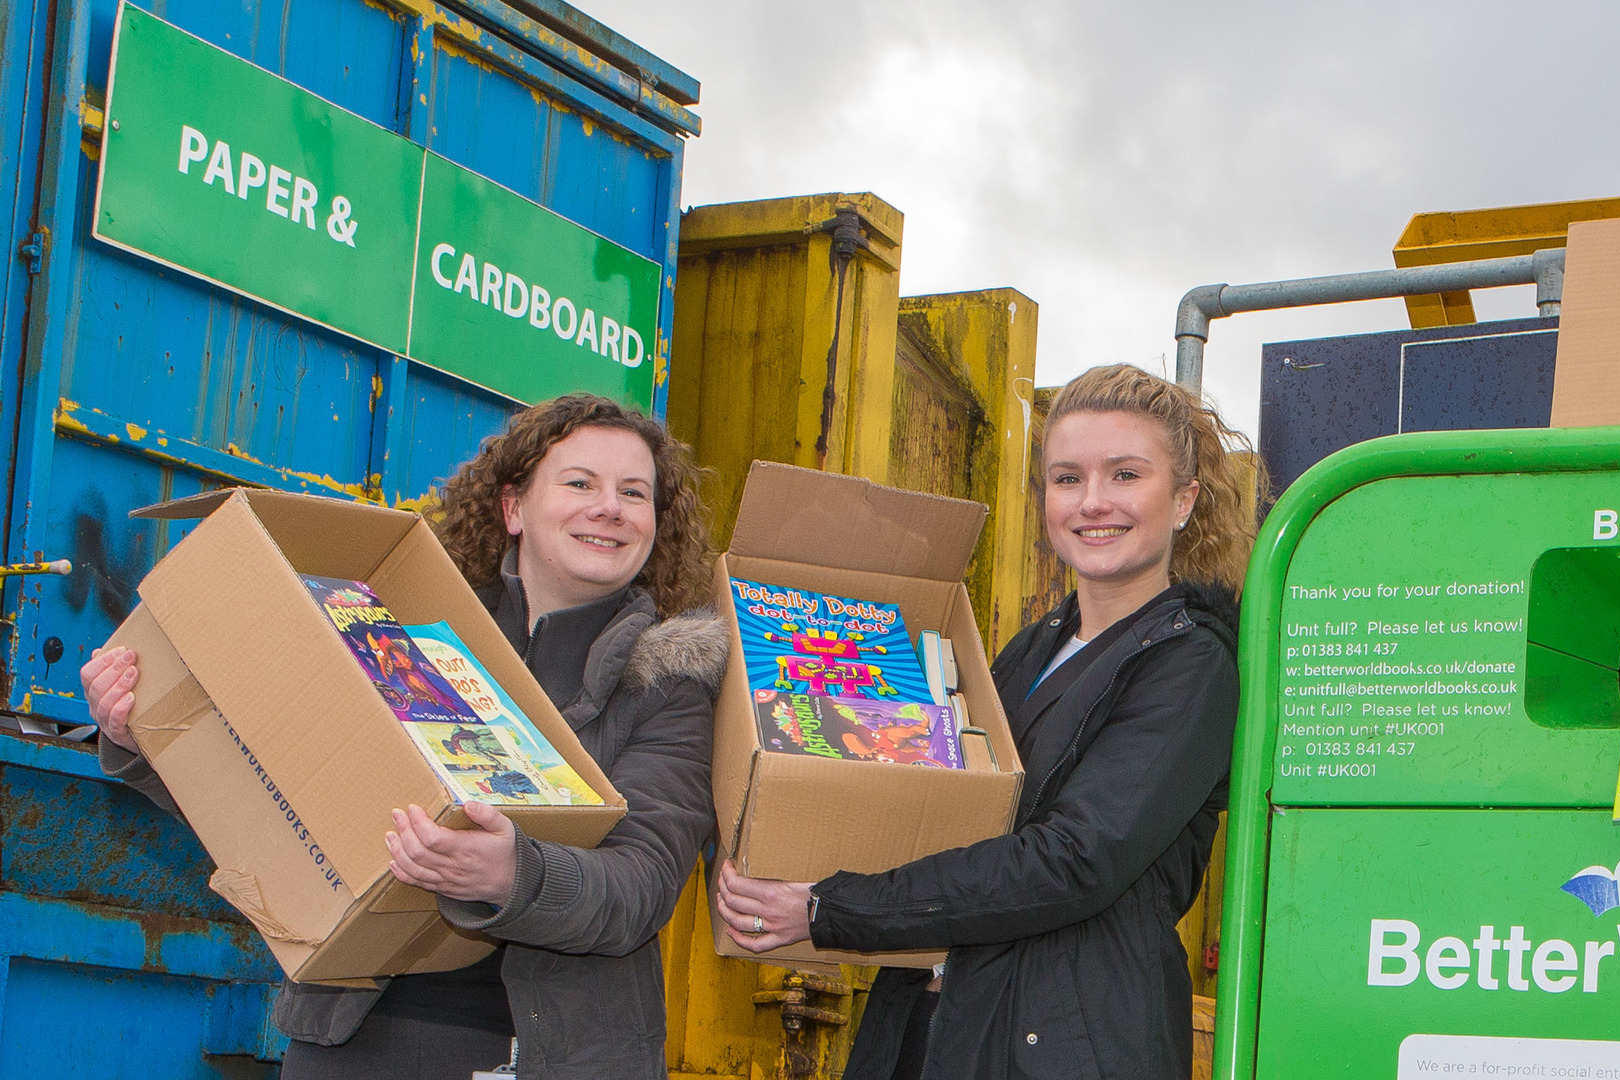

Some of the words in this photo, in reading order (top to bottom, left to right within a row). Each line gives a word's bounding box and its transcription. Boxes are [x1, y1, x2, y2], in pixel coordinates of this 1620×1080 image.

[177, 124, 319, 230] PAPER
[326, 195, 359, 249] &
[430, 242, 645, 369] CARDBOARD
[1290, 585, 1337, 600] Thank
[1342, 587, 1371, 601] you
[1377, 583, 1400, 598] for
[1404, 585, 1441, 600] your
[1446, 580, 1524, 596] donation!
[731, 580, 819, 615] Totally
[822, 595, 897, 625] Dotty
[323, 603, 396, 632] Astrosaurs
[1287, 623, 1319, 637] Unit
[1325, 621, 1358, 636] full?
[1367, 621, 1419, 635] Please
[1424, 619, 1445, 634] let
[1450, 621, 1468, 634] us
[1474, 618, 1523, 632] know!
[1287, 646, 1299, 660] p:
[1302, 643, 1342, 657] 01383
[1345, 643, 1369, 656] 841
[1373, 642, 1398, 656] 437
[1285, 667, 1301, 677] w:
[1304, 660, 1516, 677] betterworldbooks.co.uk/donate
[1284, 685, 1296, 697] e:
[1299, 680, 1518, 697] unitfull@betterworldbooks.co.uk
[1284, 703, 1315, 717] Unit
[1321, 703, 1353, 716] full?
[1362, 703, 1412, 716] Please
[1417, 702, 1436, 716] let
[1441, 704, 1459, 716] us
[1464, 702, 1511, 716] know!
[789, 693, 843, 760] Astrosaurs
[941, 708, 951, 737] Ghosts
[1283, 722, 1345, 736] Mention
[1350, 722, 1379, 736] unit
[1385, 722, 1444, 736] #UK001
[946, 738, 958, 762] Space
[1282, 744, 1296, 758] p:
[1305, 742, 1351, 756] 01383
[1355, 742, 1381, 756] 841
[1386, 742, 1416, 756] 437
[1281, 763, 1312, 777] Unit
[1317, 763, 1376, 777] #UK001
[1416, 1059, 1439, 1072] We
[1442, 1062, 1465, 1073] are
[1469, 1063, 1477, 1074] a
[1482, 1061, 1546, 1077] for-profit
[1550, 1065, 1591, 1078] social
